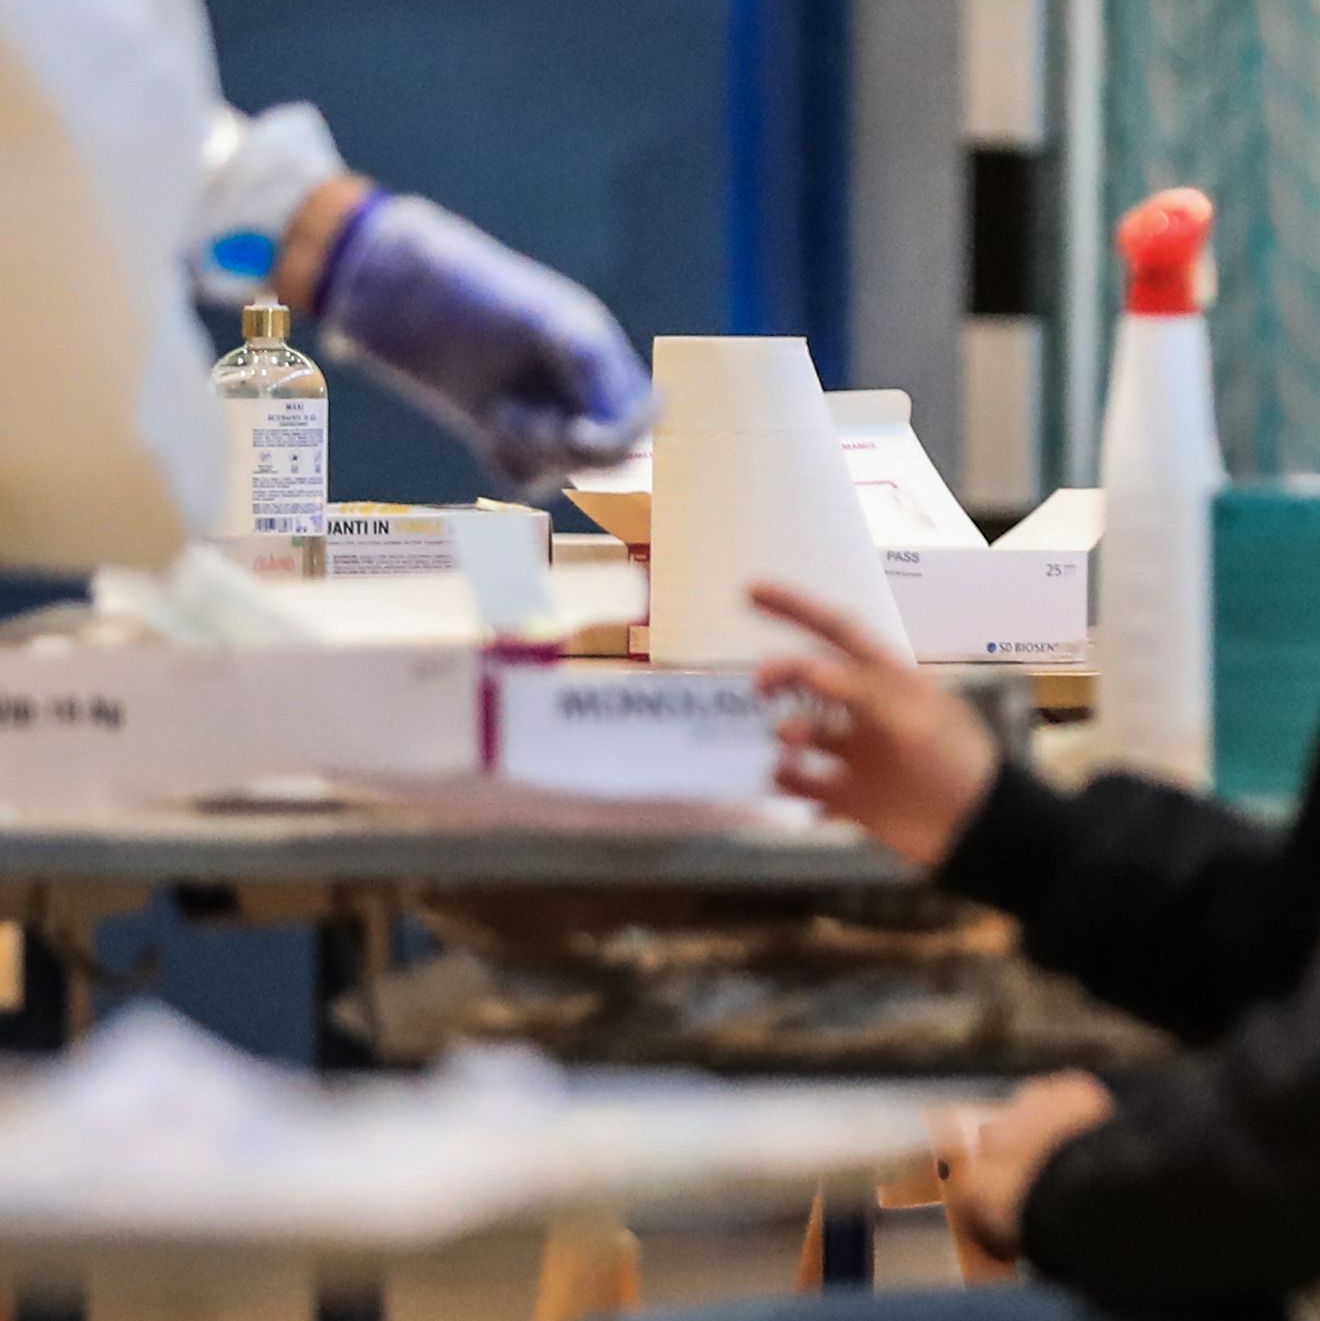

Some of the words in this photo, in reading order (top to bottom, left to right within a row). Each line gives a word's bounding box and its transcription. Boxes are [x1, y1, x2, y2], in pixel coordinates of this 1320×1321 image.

[373, 520, 389, 535] IN
[886, 550, 920, 563] PASS
[1045, 563, 1062, 576] 25
[1014, 642, 1058, 653] BIOSEN
